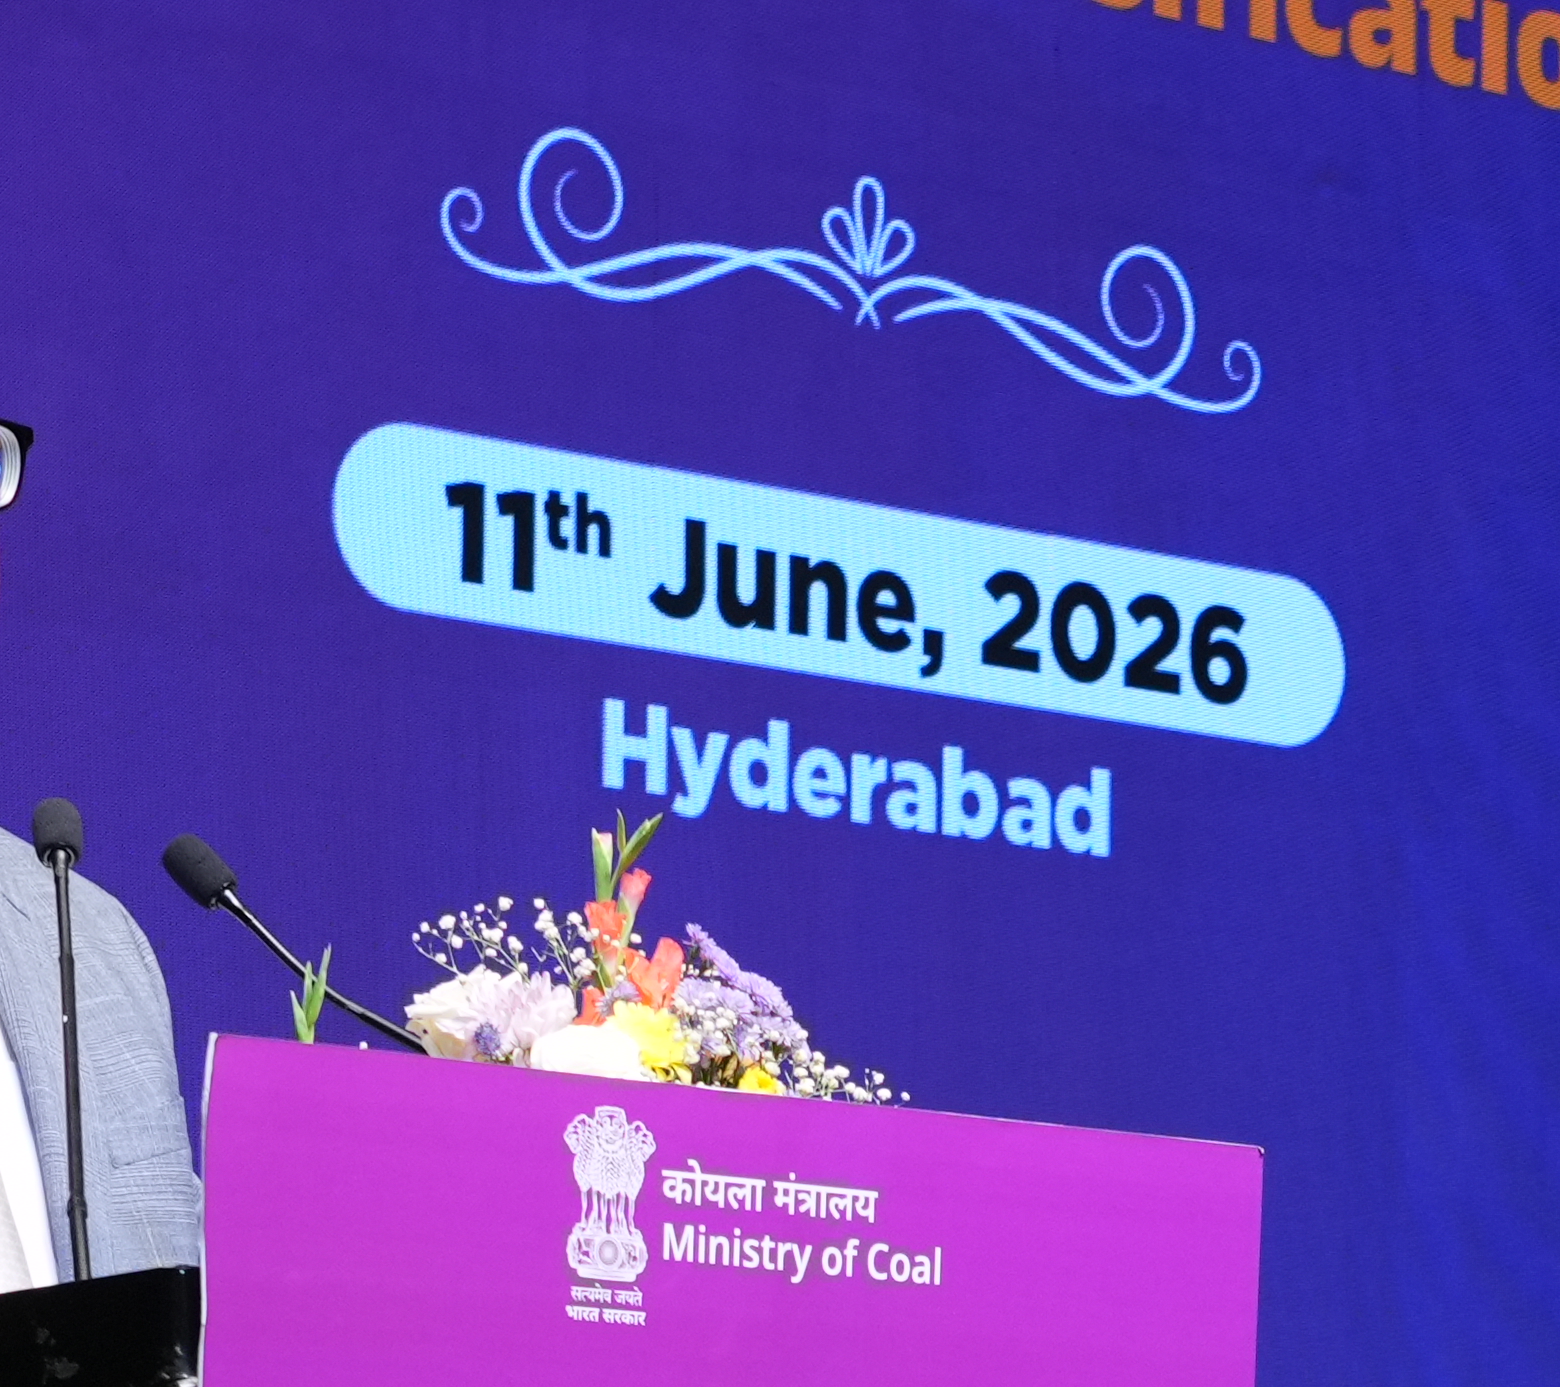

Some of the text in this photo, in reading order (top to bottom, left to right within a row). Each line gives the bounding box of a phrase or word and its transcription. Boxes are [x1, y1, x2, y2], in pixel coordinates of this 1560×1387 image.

[445, 481, 1249, 705] 11th June, 2026
[600, 697, 1112, 858] Hyderabad
[661, 1158, 878, 1223] कोयला मंत्रालय
[662, 1222, 942, 1286] Ministry of Coal
[565, 1305, 646, 1326] भारत सरकार
